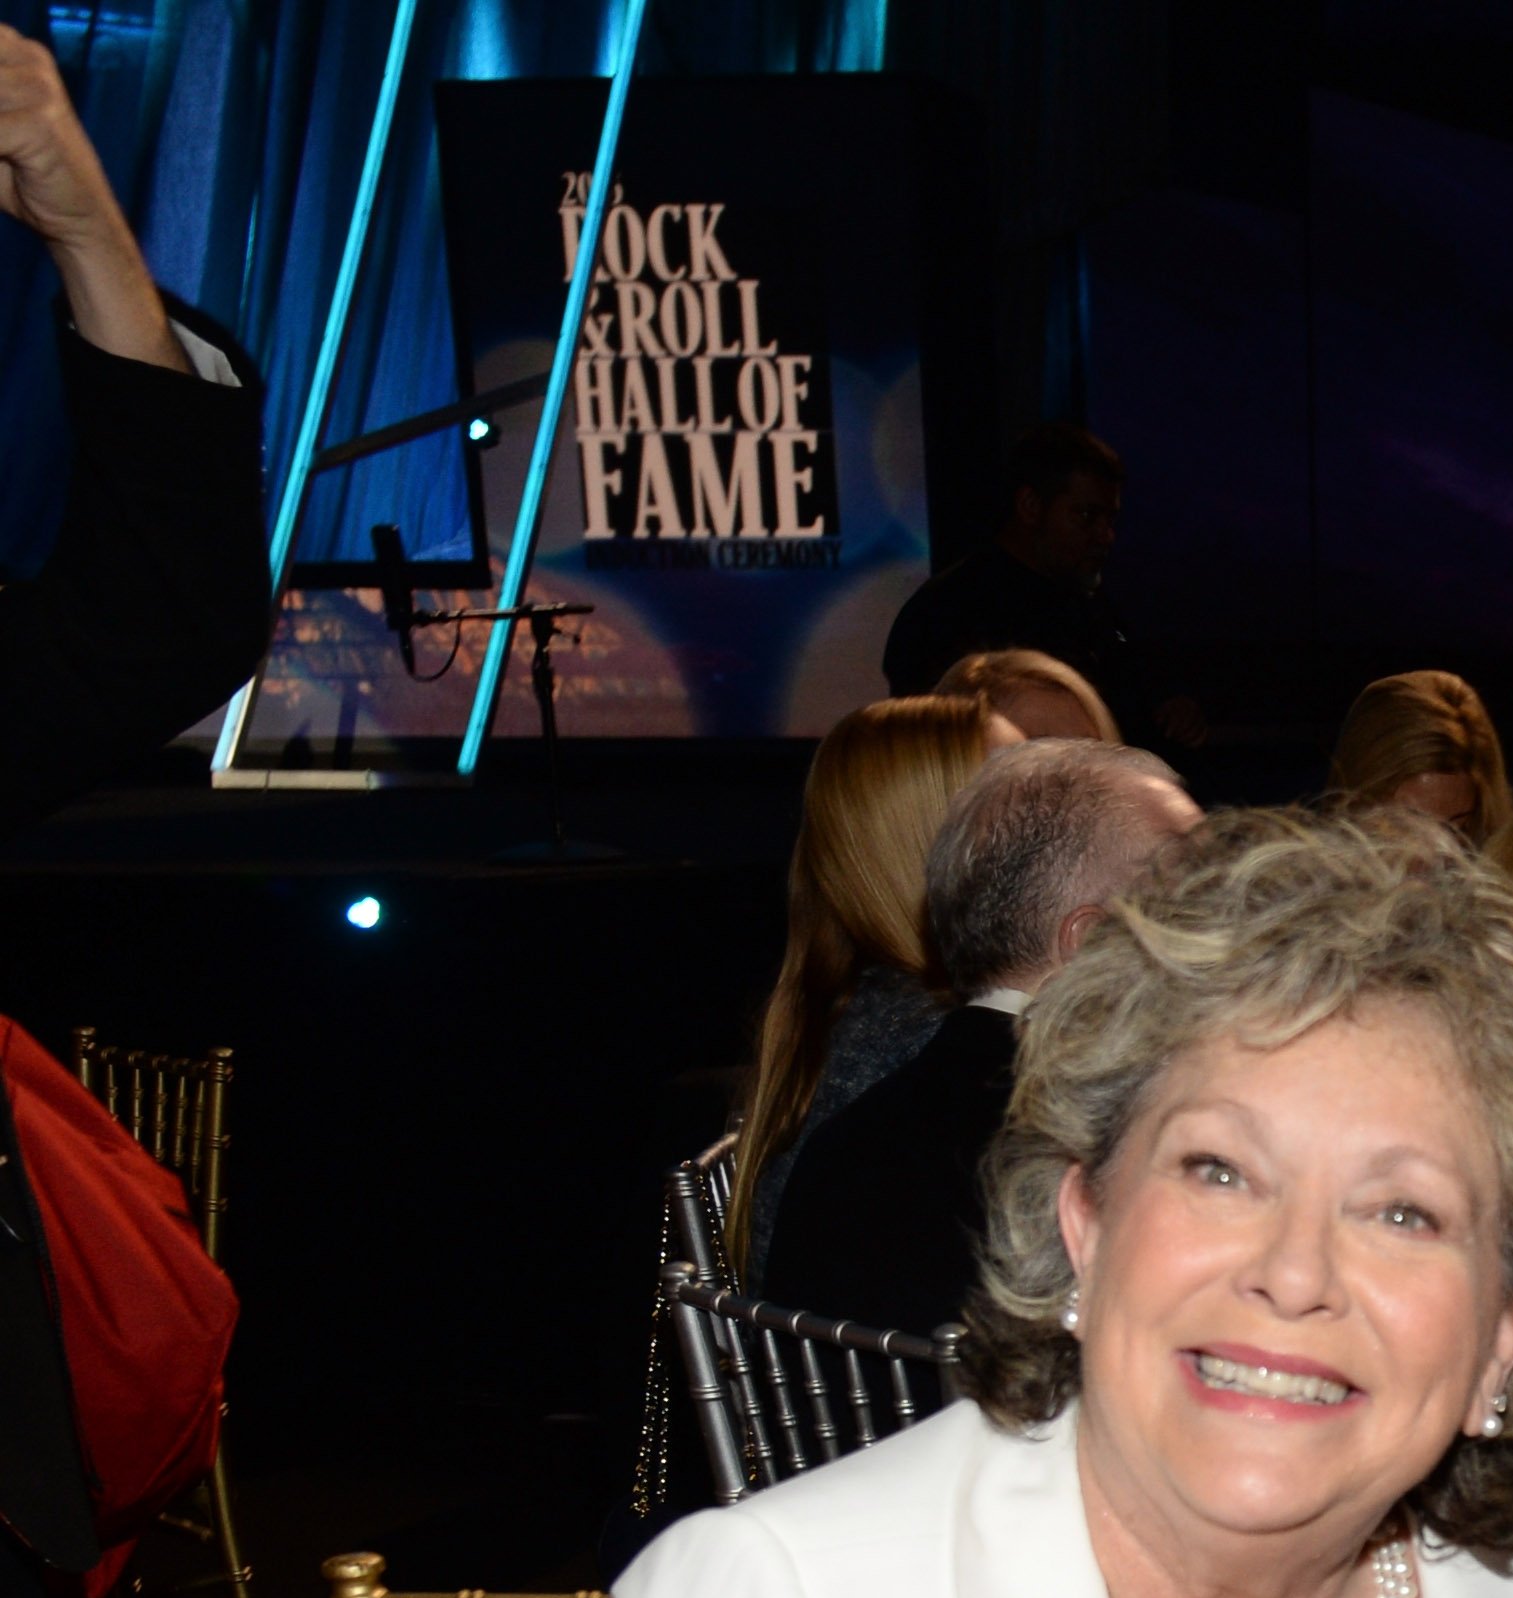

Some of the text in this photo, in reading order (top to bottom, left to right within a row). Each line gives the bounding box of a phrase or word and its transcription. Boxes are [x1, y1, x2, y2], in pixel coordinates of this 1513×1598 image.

[575, 356, 813, 433] HALL OF
[577, 432, 825, 539] FAME
[716, 542, 842, 570] CEREMONY
